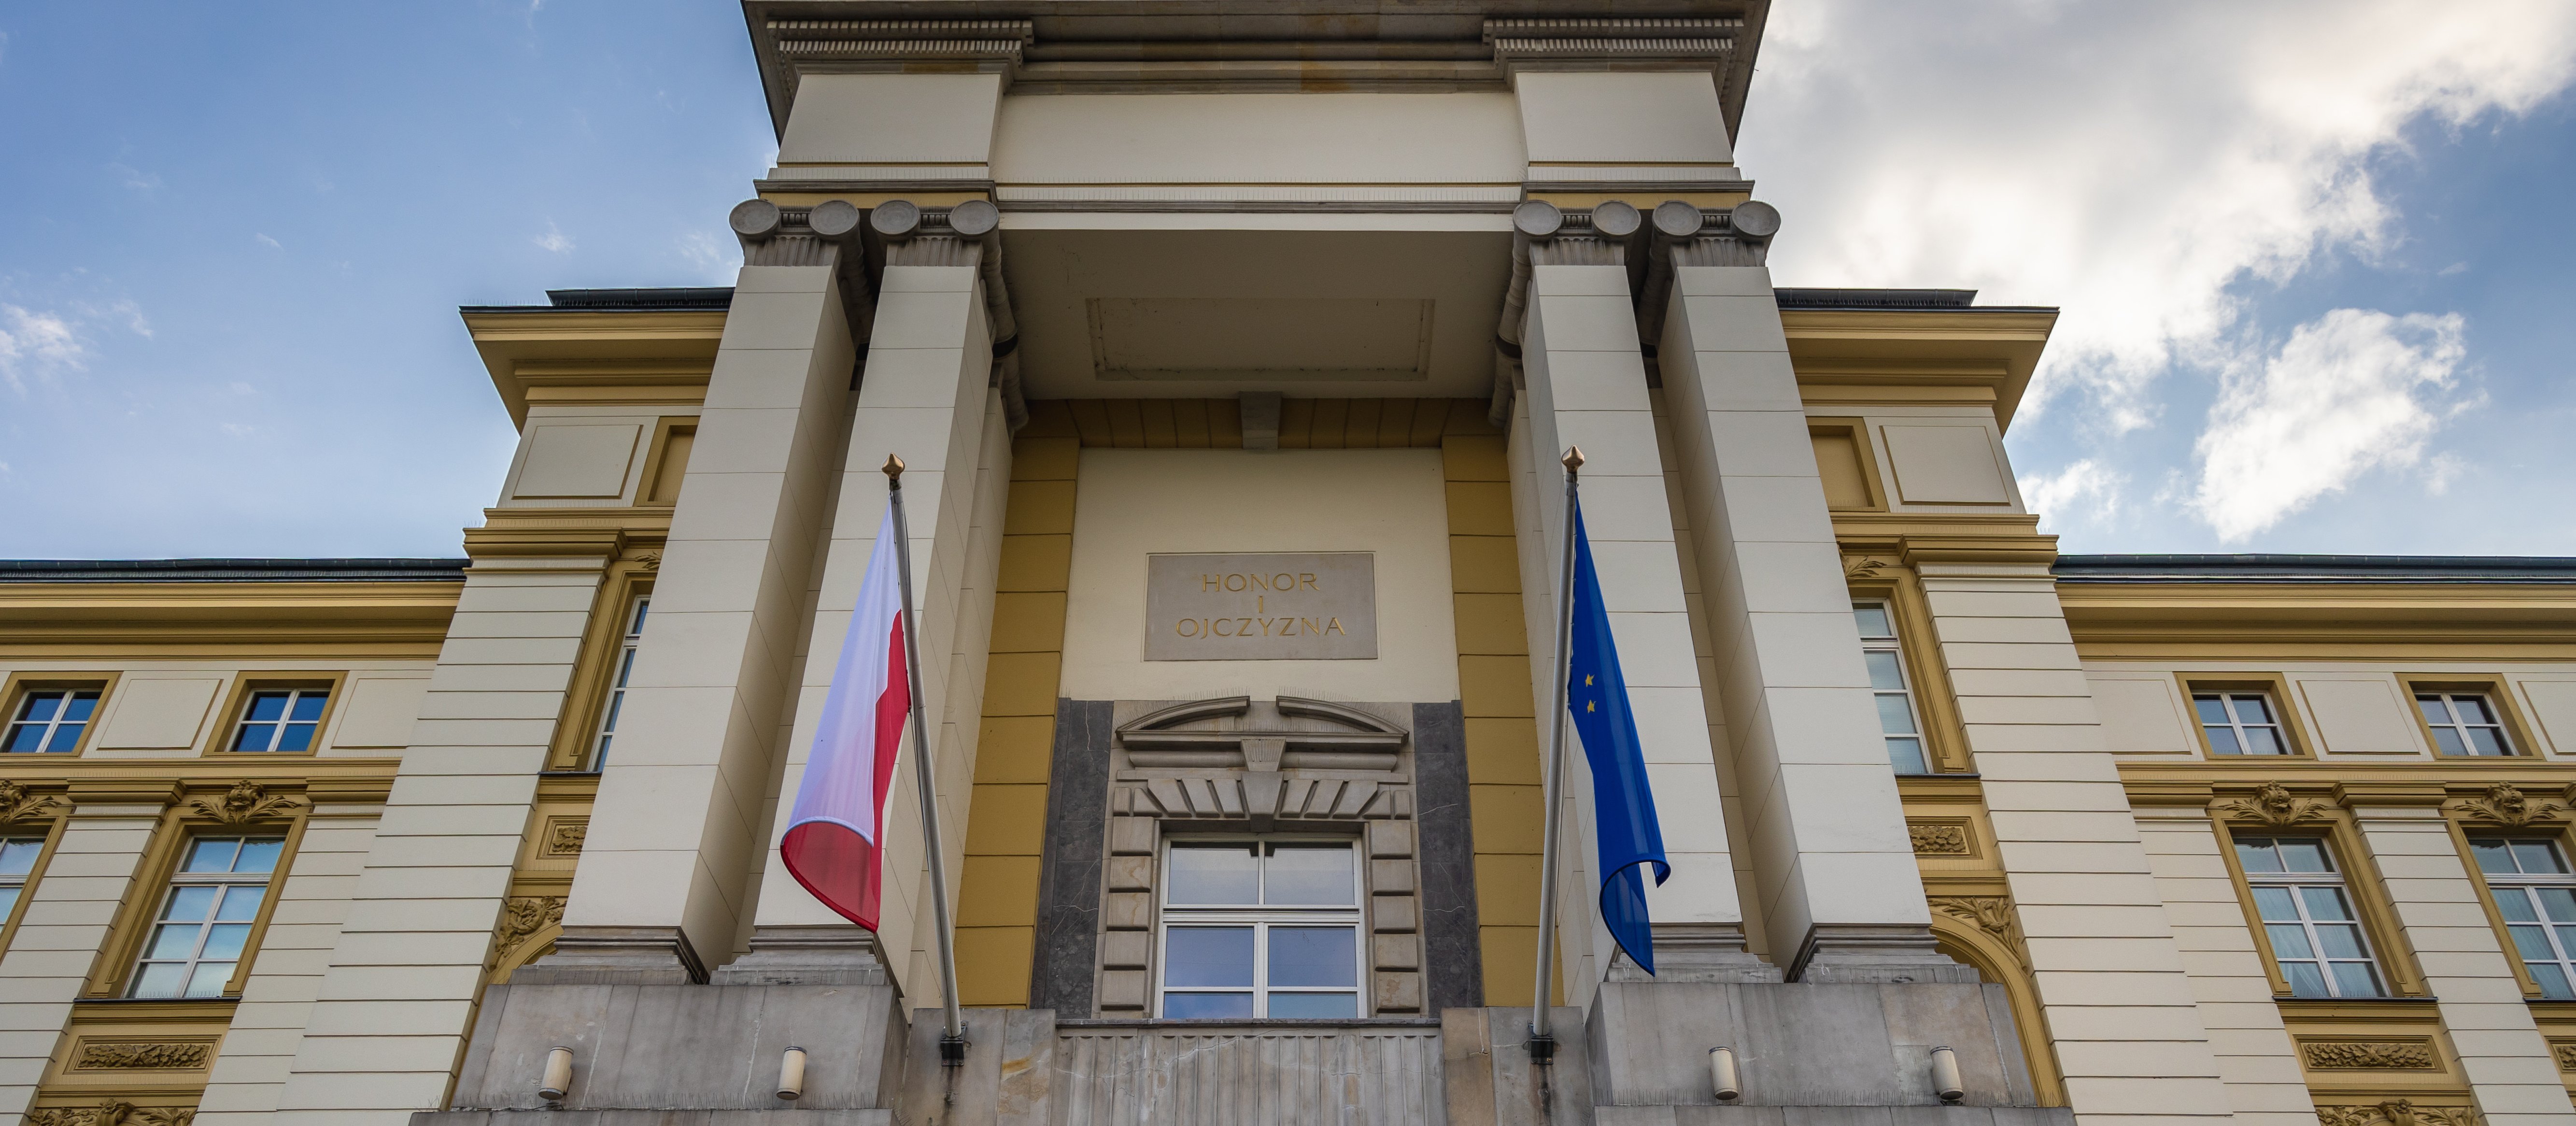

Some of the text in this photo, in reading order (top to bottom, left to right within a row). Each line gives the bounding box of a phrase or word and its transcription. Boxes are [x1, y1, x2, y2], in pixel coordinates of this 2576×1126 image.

[1202, 573, 1320, 592] HONOR
[1259, 595, 1263, 614] I
[1176, 617, 1345, 639] OJCZYZNA
